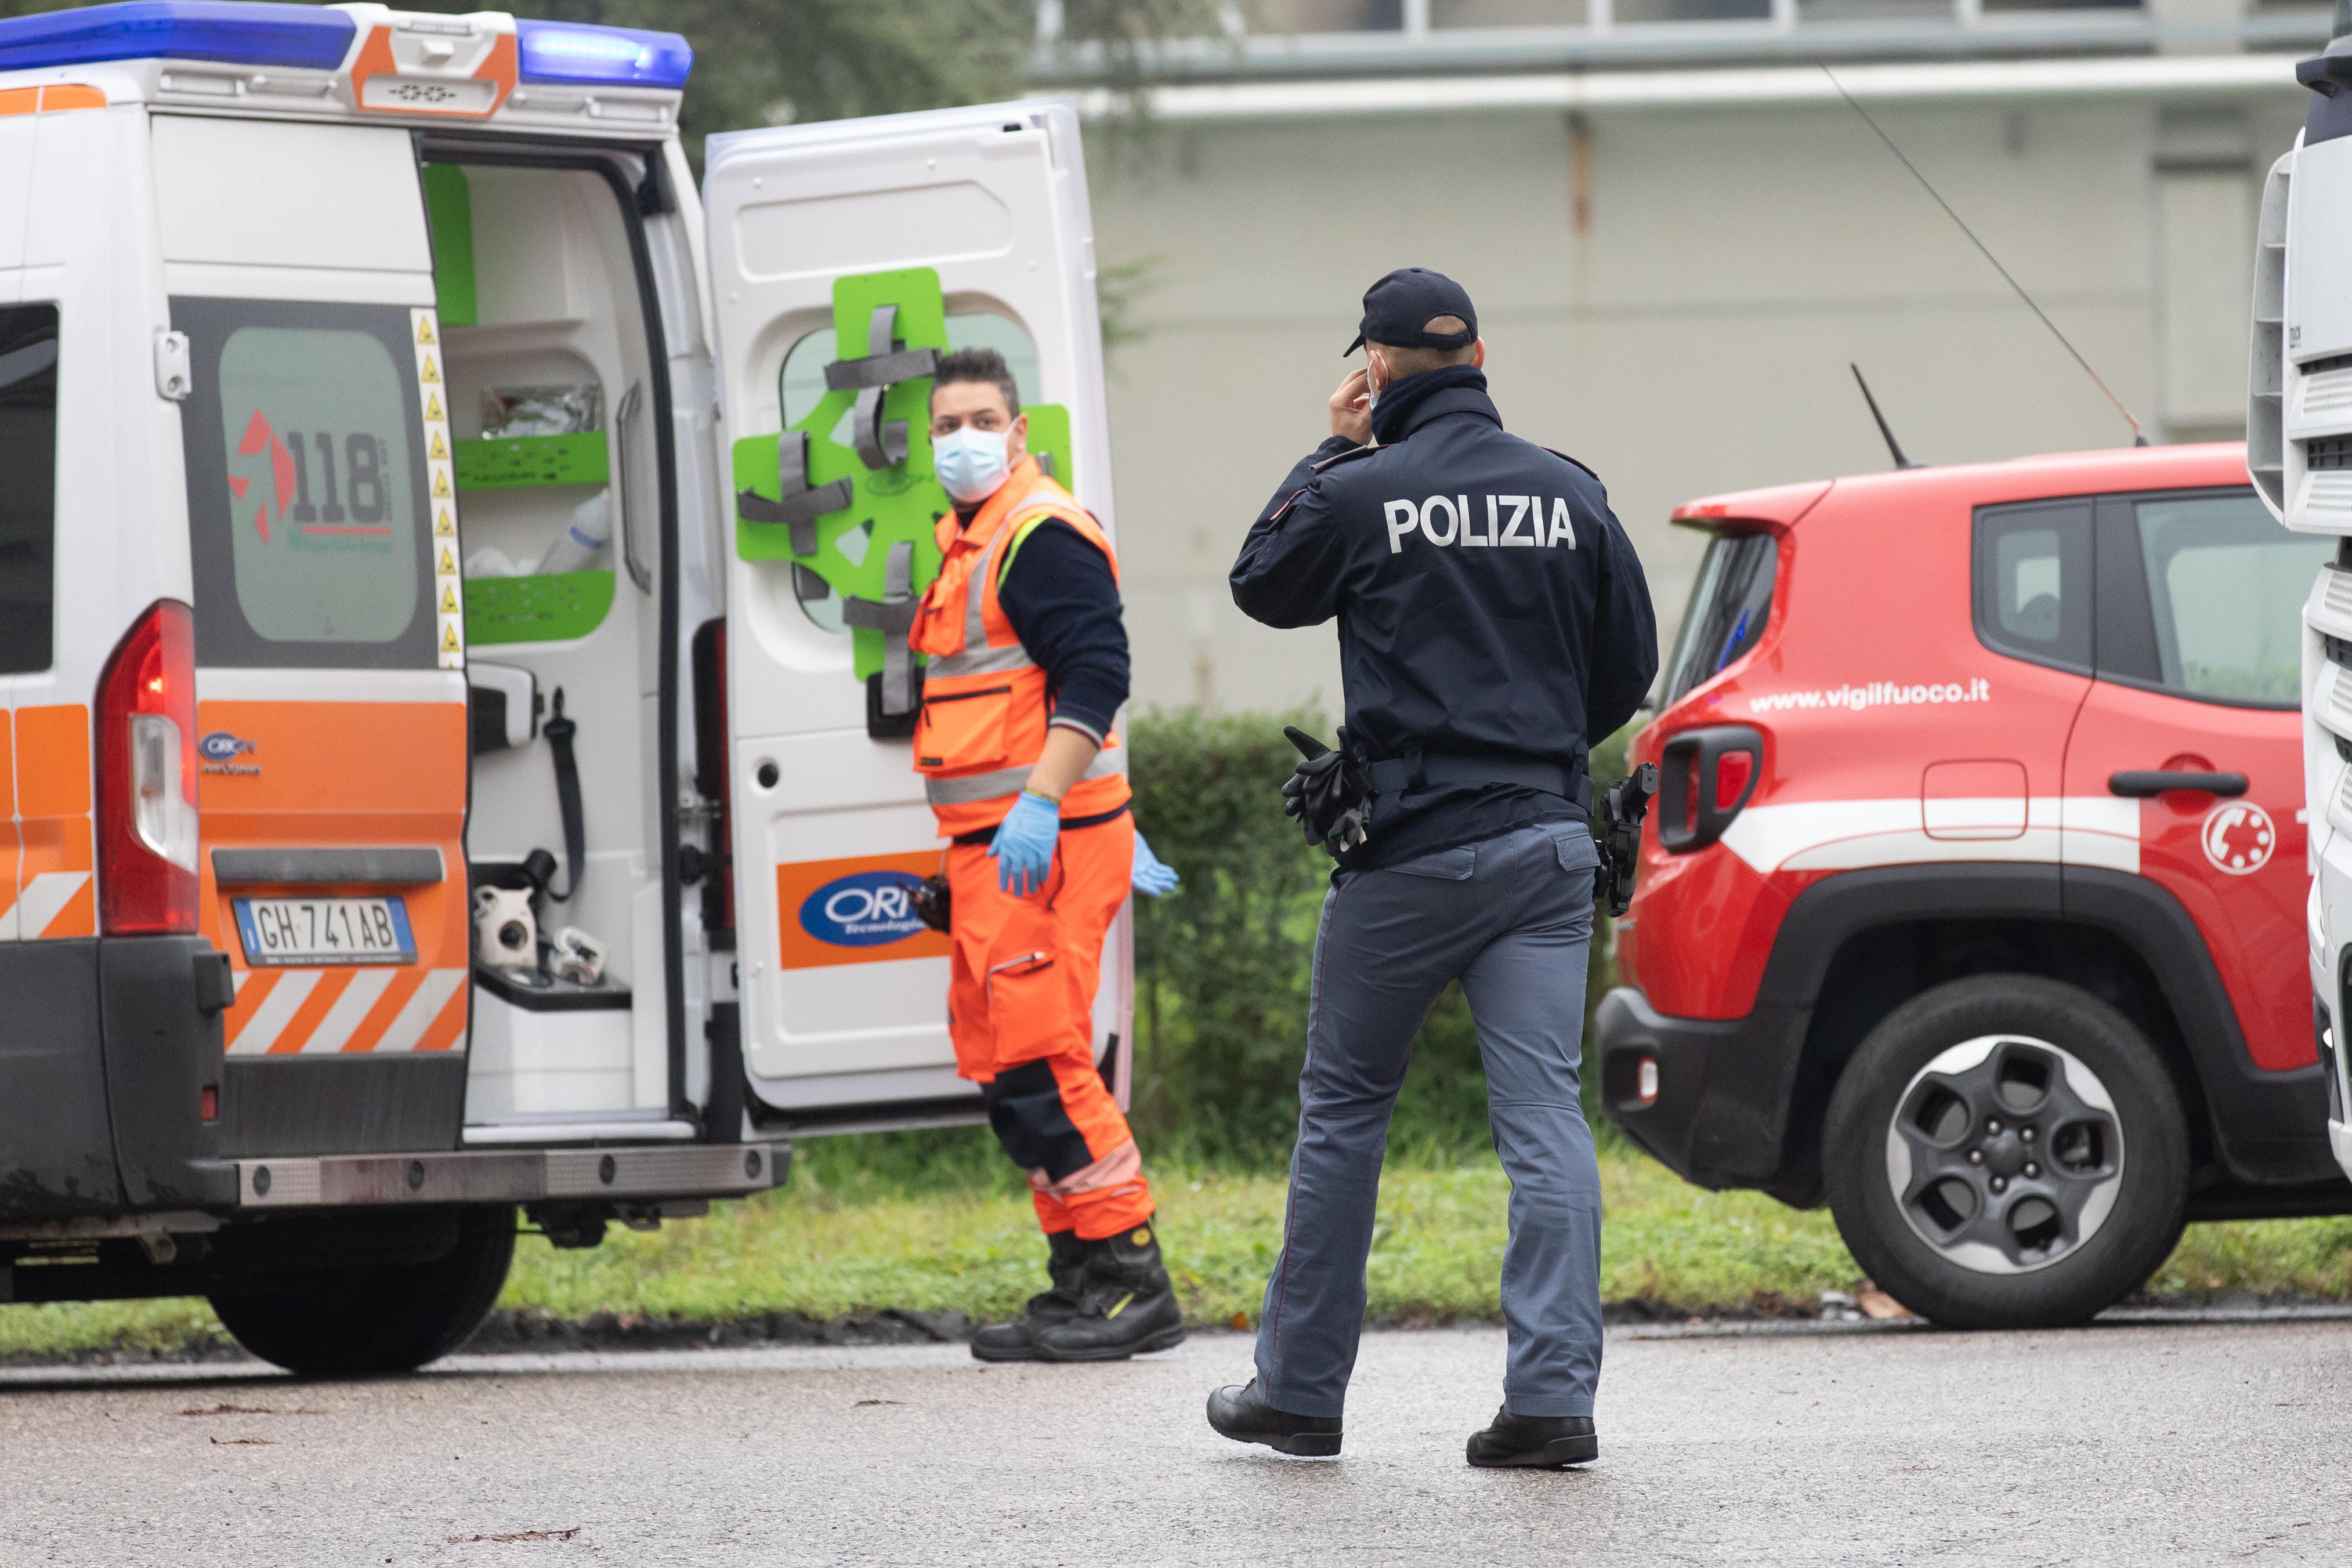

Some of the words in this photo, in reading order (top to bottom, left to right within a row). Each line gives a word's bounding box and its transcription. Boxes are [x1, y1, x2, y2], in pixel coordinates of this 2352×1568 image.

[287, 431, 383, 524] 118
[1384, 494, 1576, 553] POLIZIA
[1750, 677, 1990, 712] www.vigilfuoco.it
[824, 886, 909, 924] ORI
